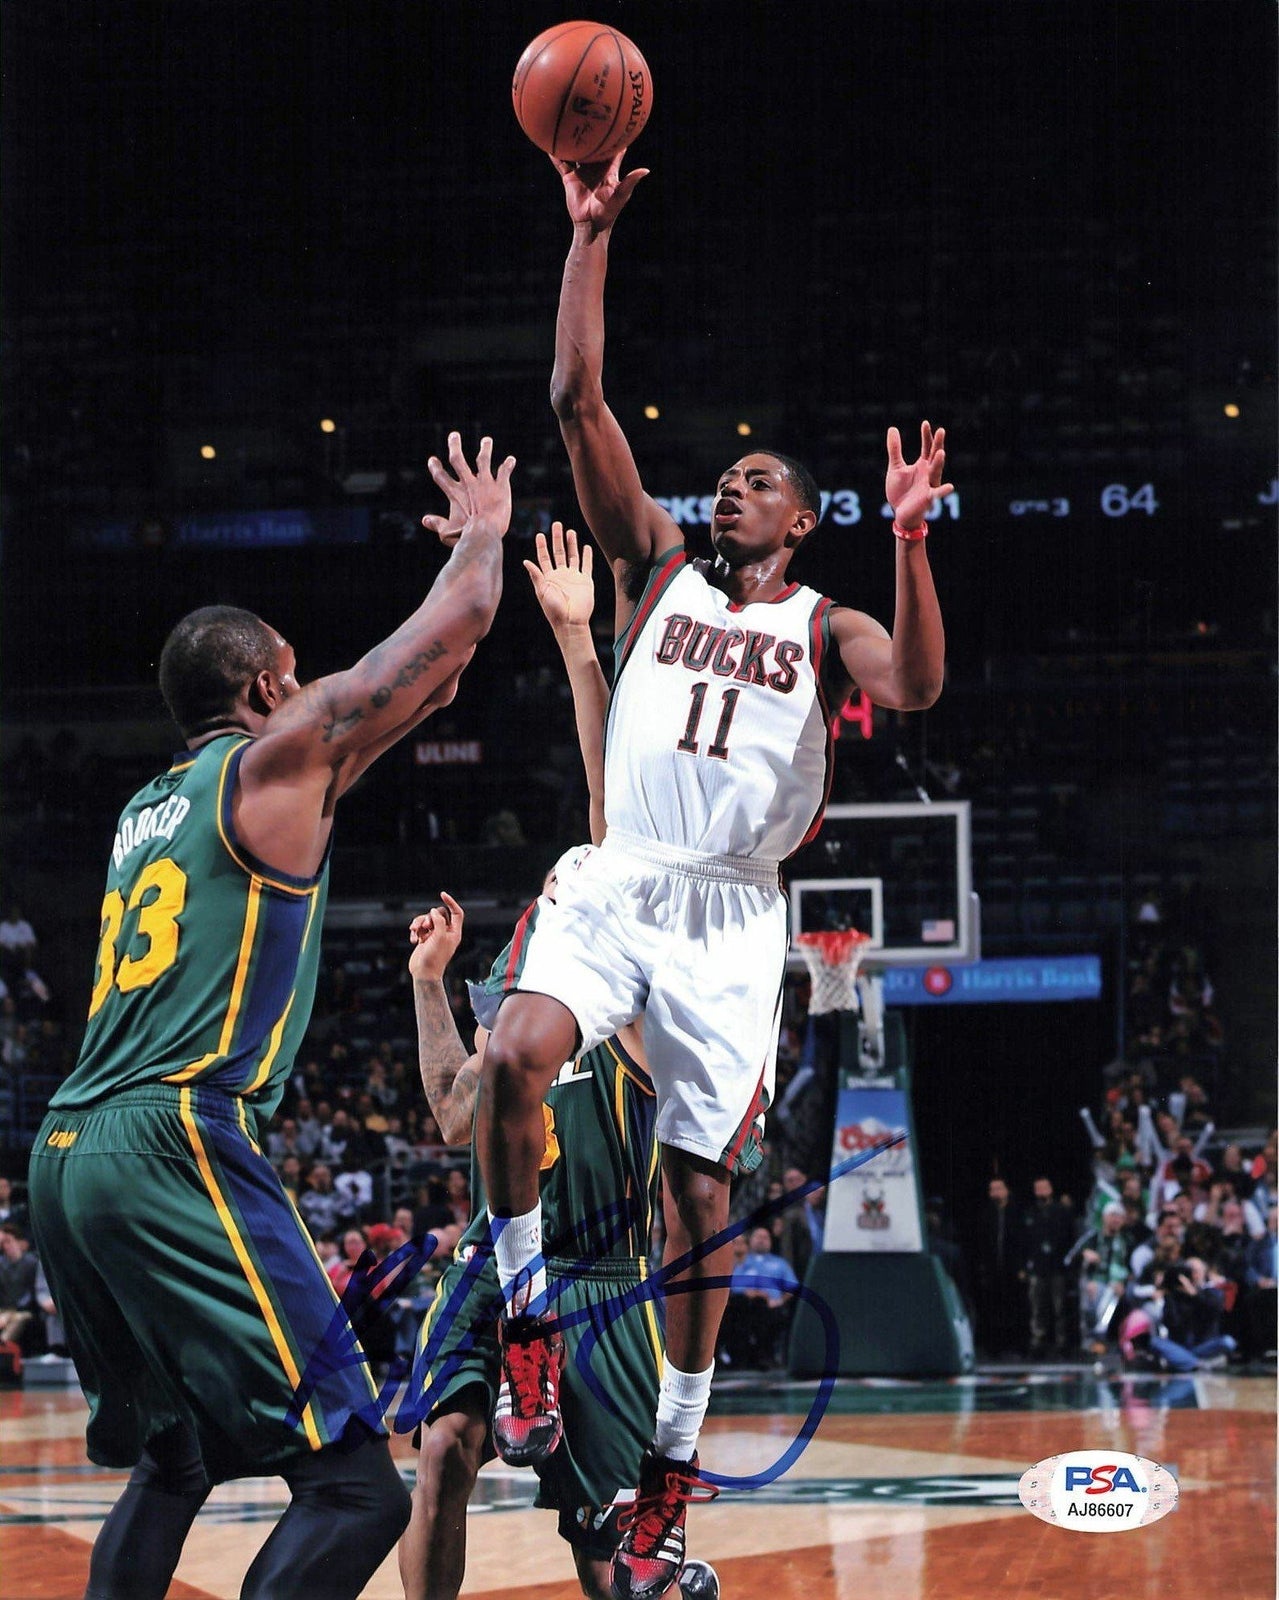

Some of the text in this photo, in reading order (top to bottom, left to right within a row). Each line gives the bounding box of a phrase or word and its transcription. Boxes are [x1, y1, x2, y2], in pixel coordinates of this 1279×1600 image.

[1100, 483, 1159, 517] 64
[656, 613, 804, 694] BUCKS
[677, 682, 740, 760] 11
[112, 794, 191, 872] BOOKER
[88, 857, 188, 1021] 33
